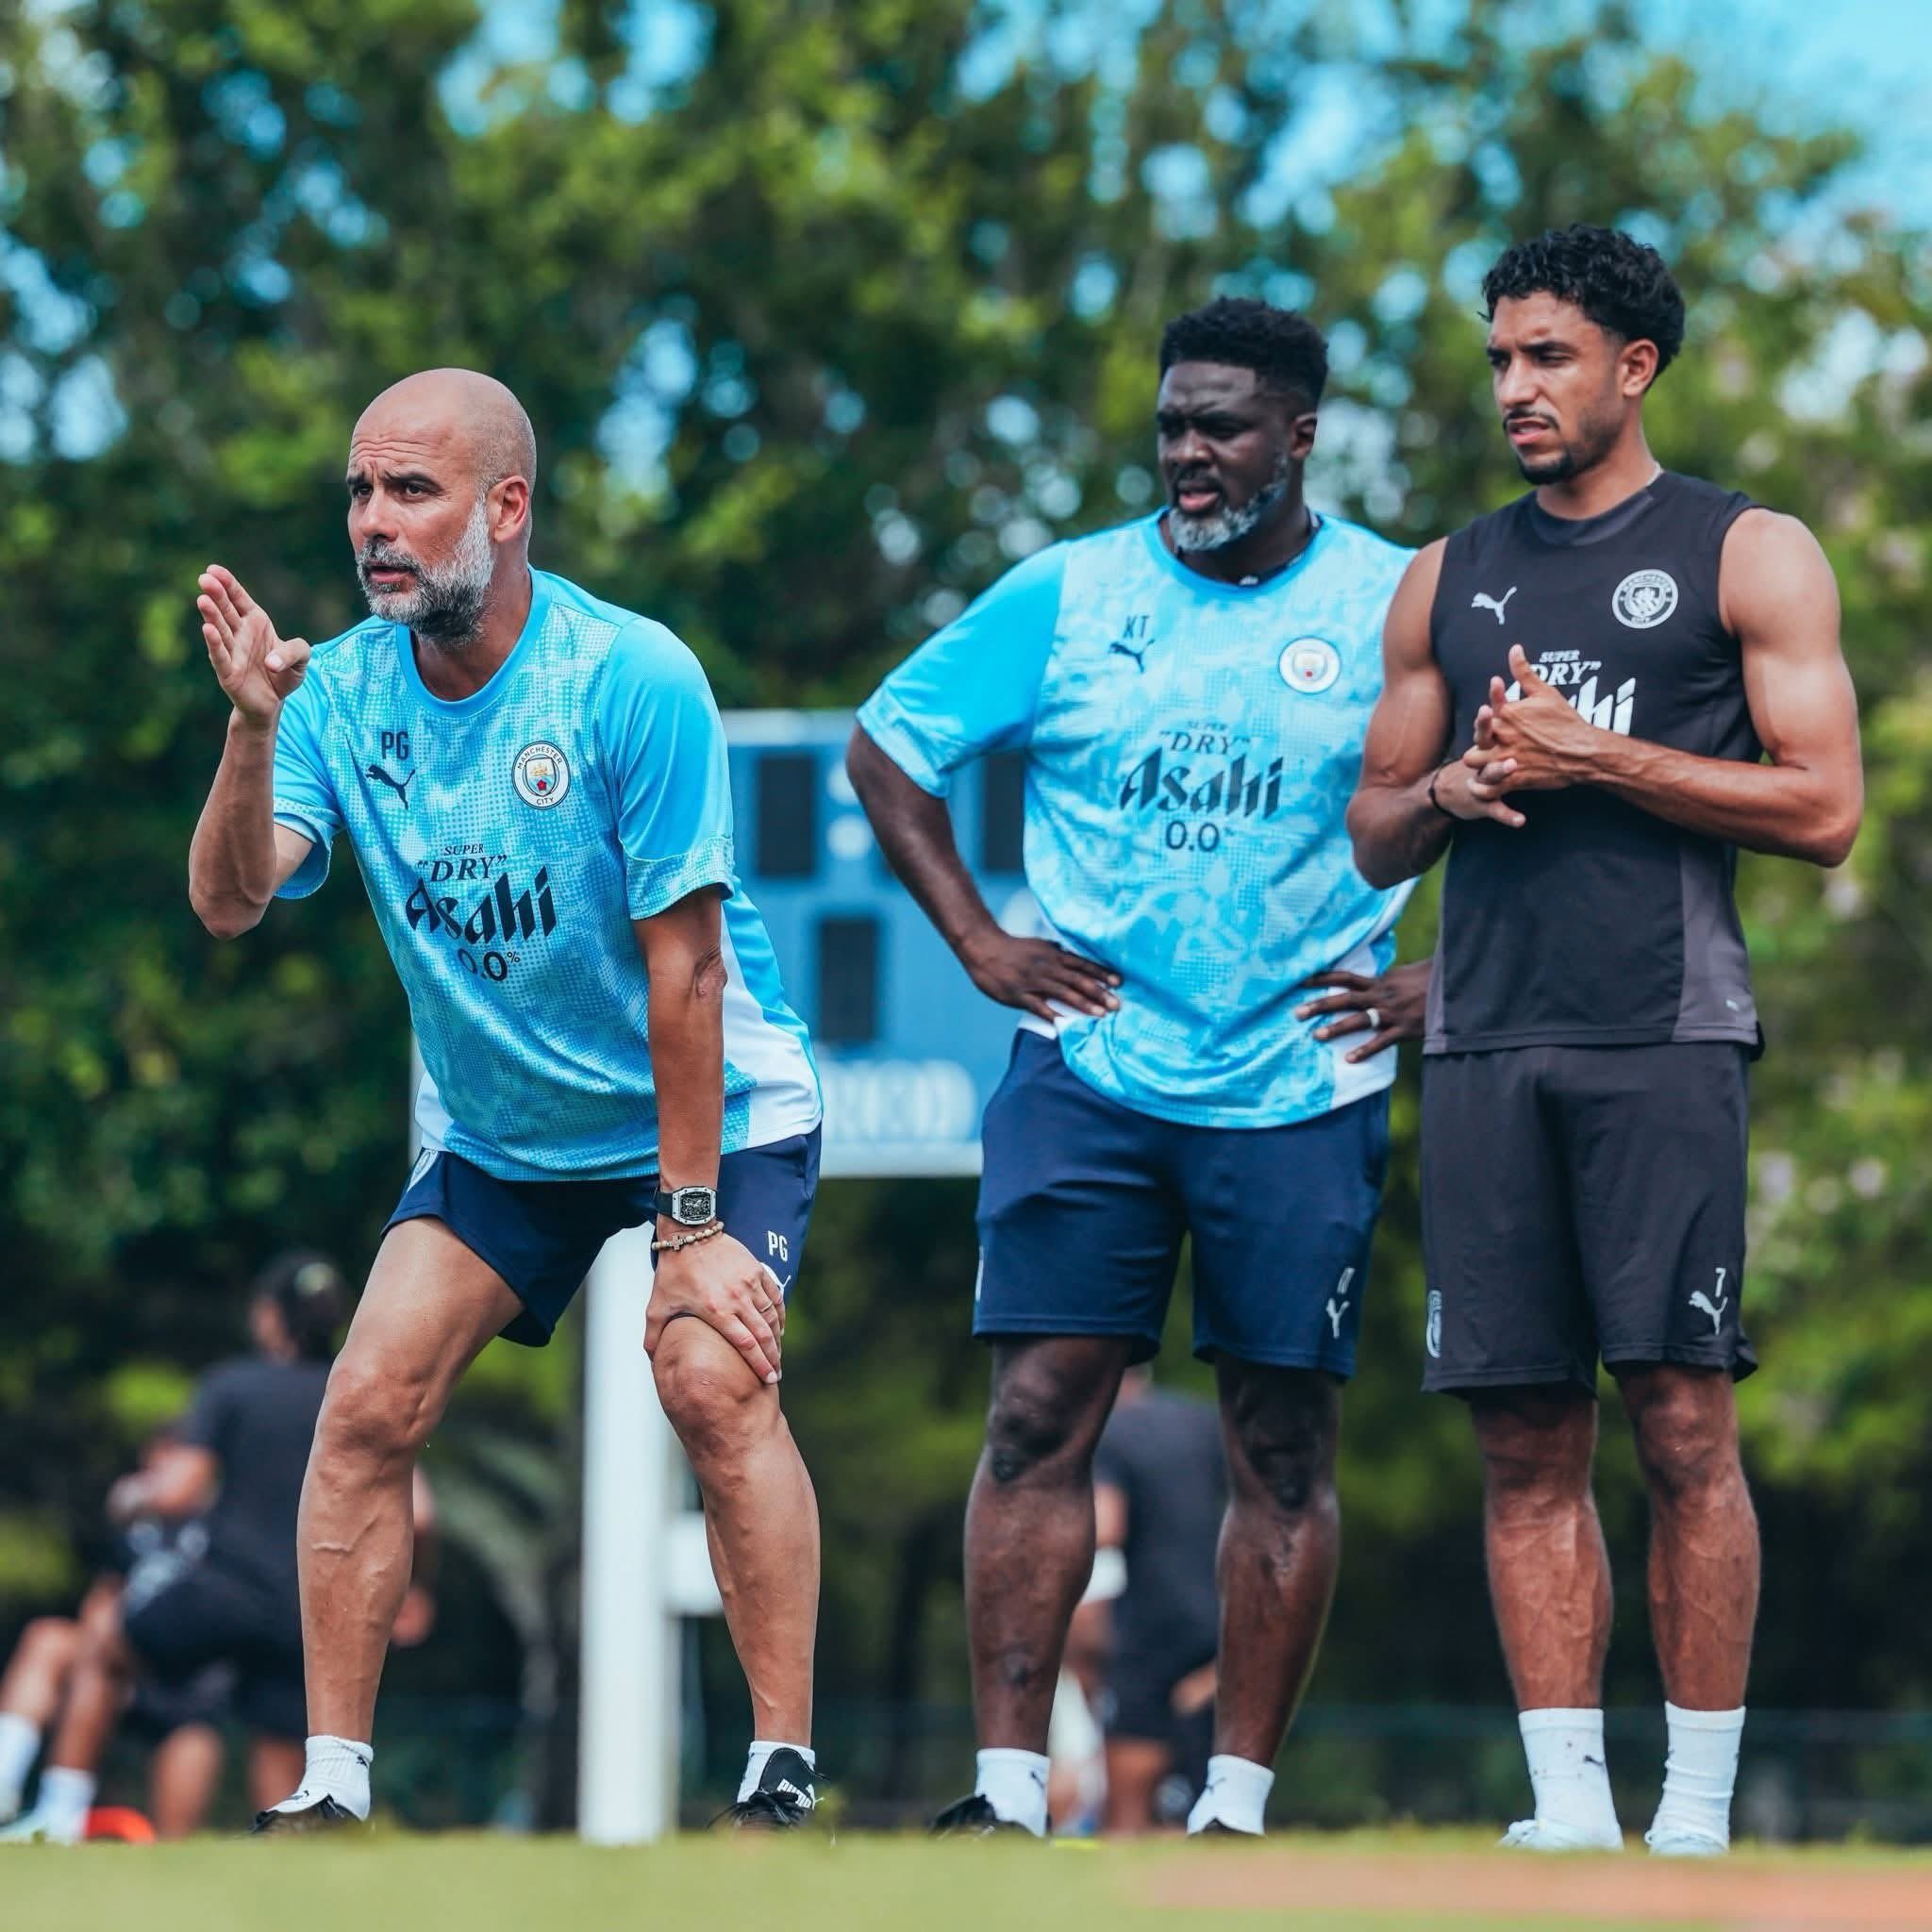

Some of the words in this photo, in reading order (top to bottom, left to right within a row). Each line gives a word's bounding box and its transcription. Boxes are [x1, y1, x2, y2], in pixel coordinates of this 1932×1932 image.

[1540, 649, 1580, 662] SUPER
[381, 731, 409, 760] PG
[517, 746, 563, 770] MANCHESTER
[1120, 746, 1283, 820] Asahi
[536, 797, 554, 806] CITY
[443, 844, 484, 857] SUPER
[405, 866, 558, 944] Asahi
[767, 1230, 789, 1262] PG
[1715, 1268, 1726, 1298] 7
